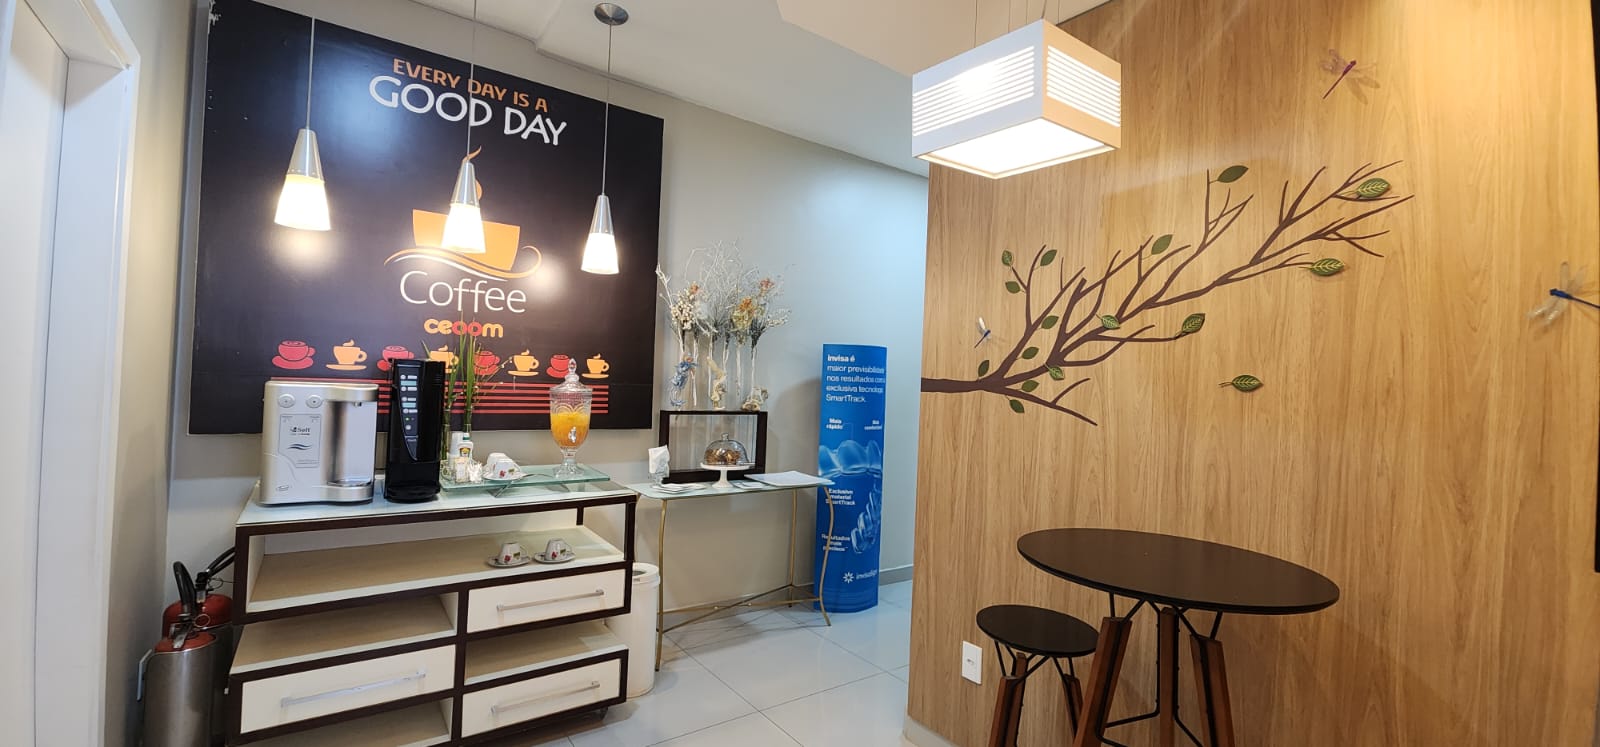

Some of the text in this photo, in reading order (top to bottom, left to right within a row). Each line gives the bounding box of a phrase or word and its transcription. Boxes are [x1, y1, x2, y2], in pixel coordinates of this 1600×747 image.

[393, 58, 548, 113] EVERY DAY IS A
[369, 75, 567, 146] GOOD DAY
[400, 270, 527, 313] Coffee
[826, 385, 858, 393] exclusiva
